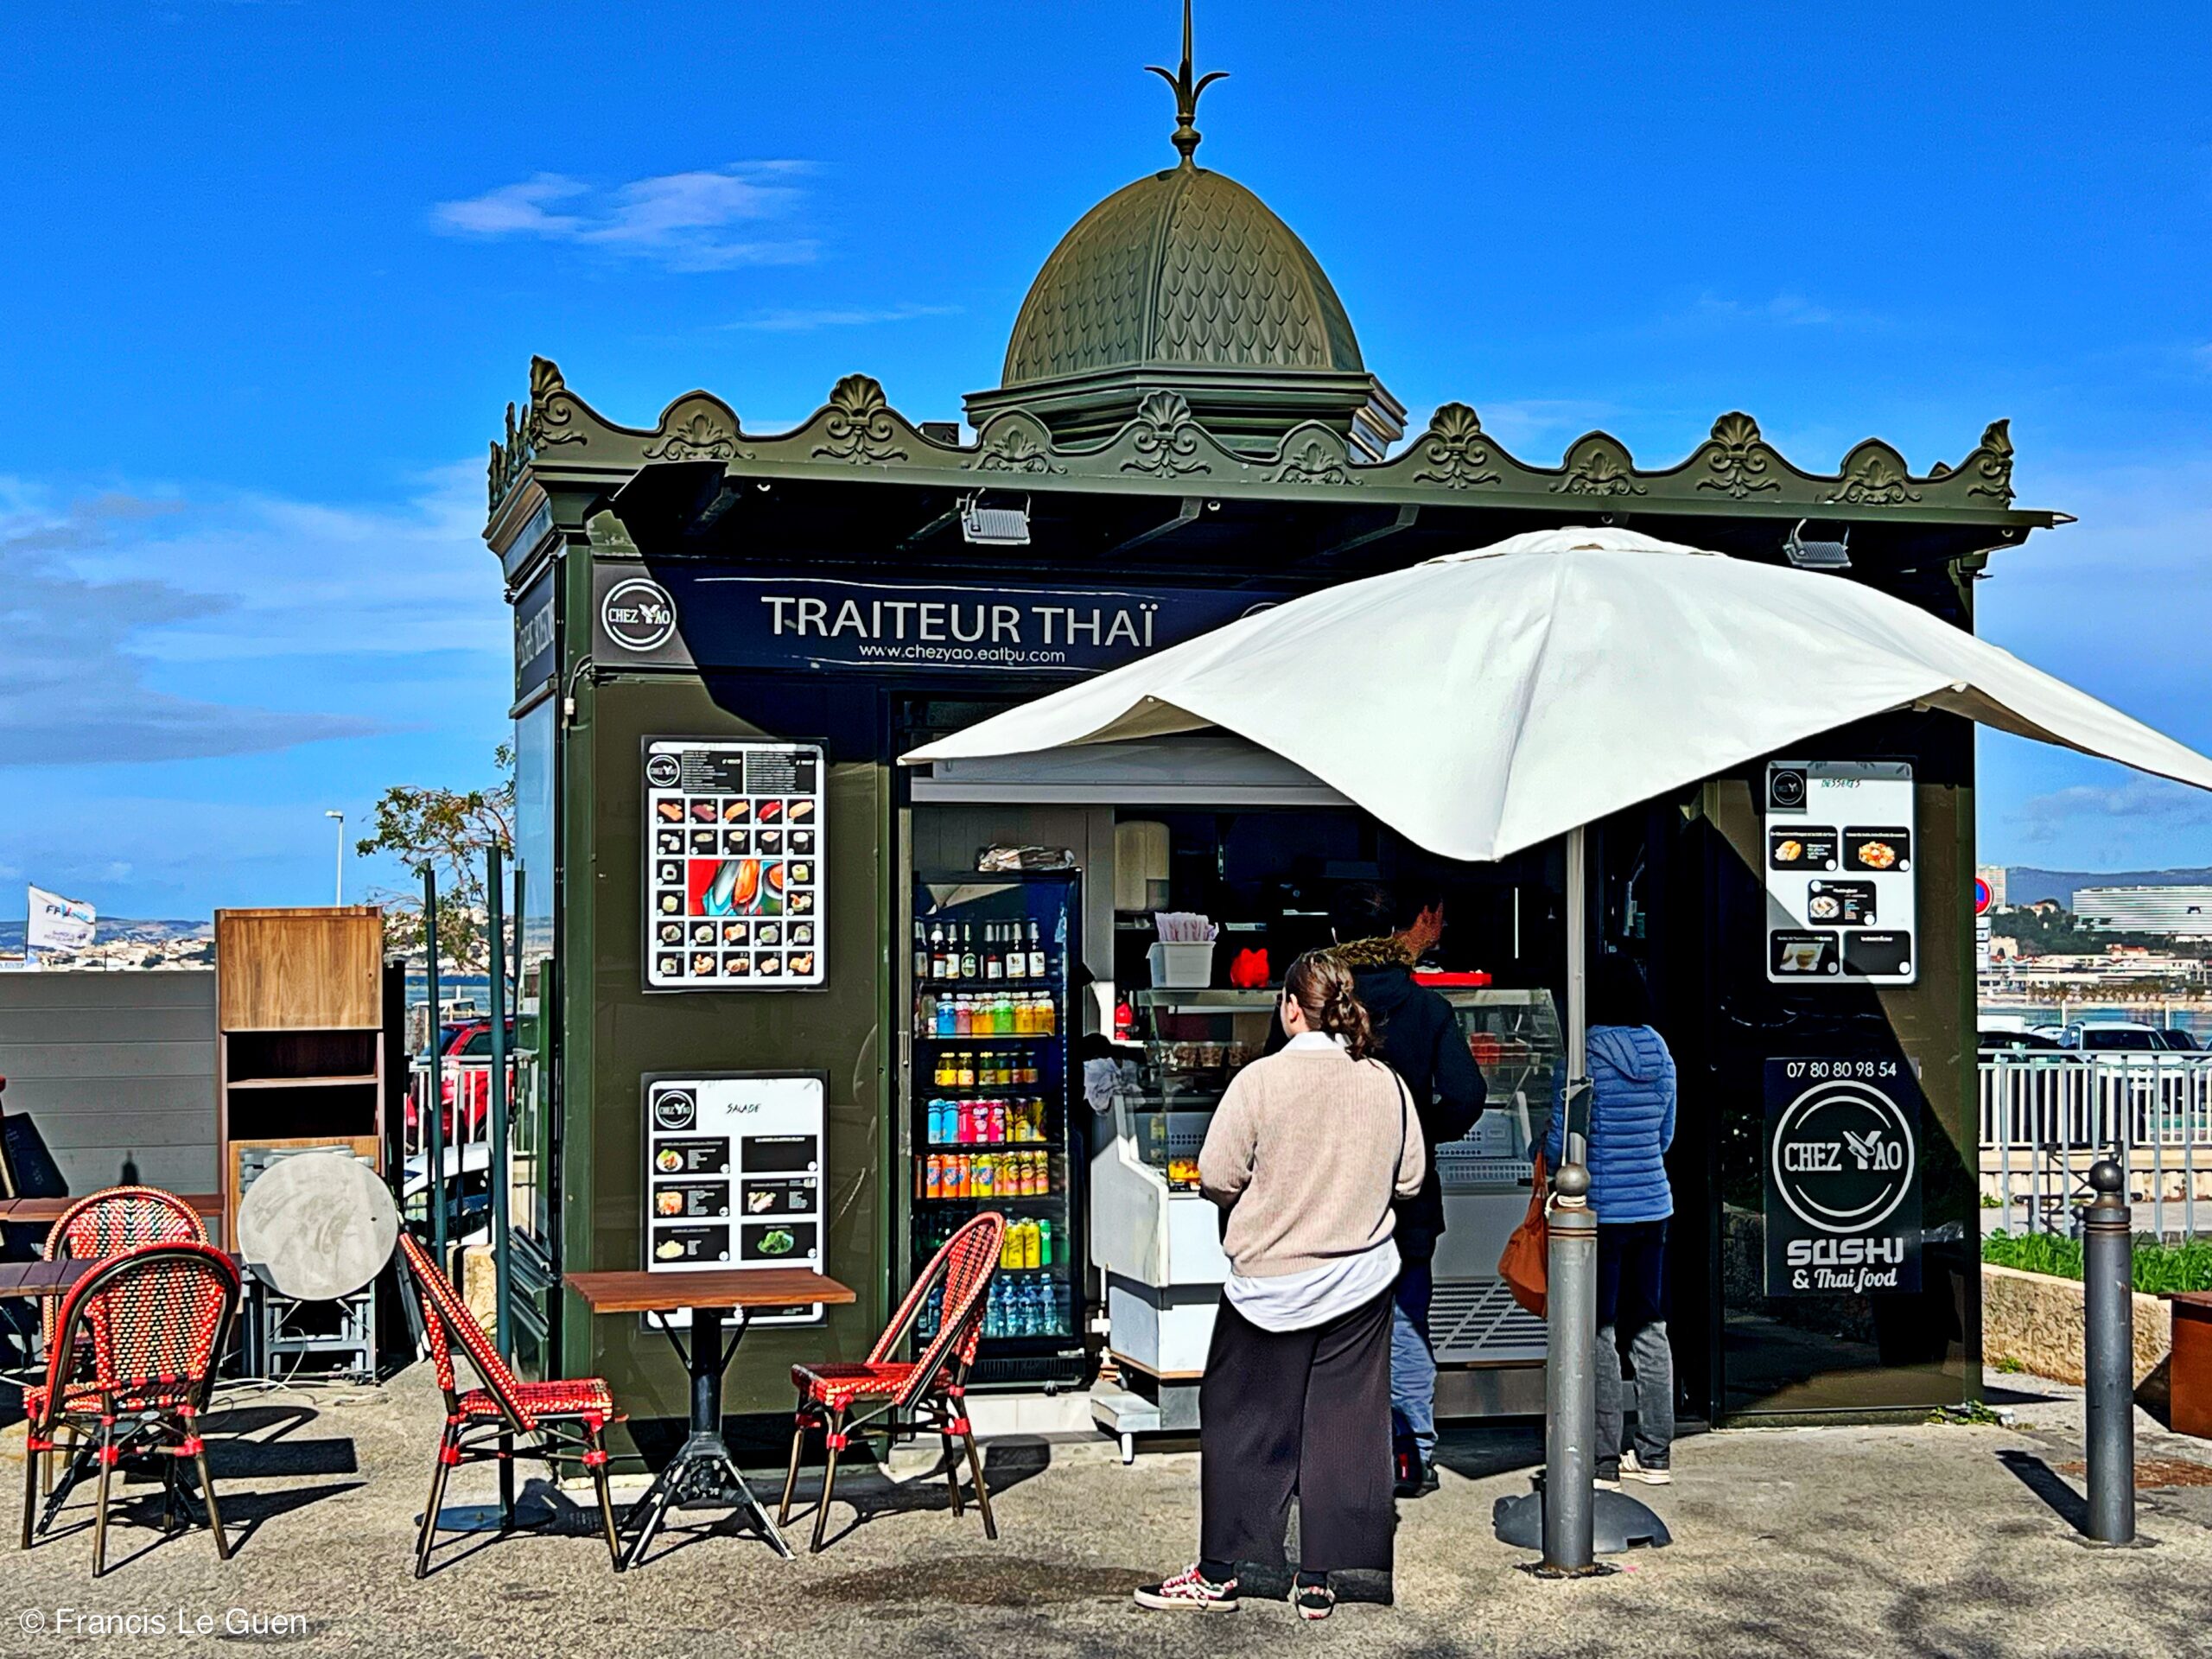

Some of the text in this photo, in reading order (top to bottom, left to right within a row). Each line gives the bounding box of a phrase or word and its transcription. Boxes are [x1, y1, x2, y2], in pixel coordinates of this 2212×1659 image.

[607, 603, 671, 625] CHEZ YAO
[760, 595, 1159, 649] TRAITEUR THAÏ
[859, 645, 1065, 664] www.chezyao.eatbu.com
[1787, 1062, 1897, 1078] 07 80 80 98 54
[726, 1103, 762, 1115] SALADE
[1784, 1130, 1903, 1172] CHEZ YAO
[1787, 1237, 1904, 1266] SUSHI
[1792, 1267, 1897, 1294] & Thai food
